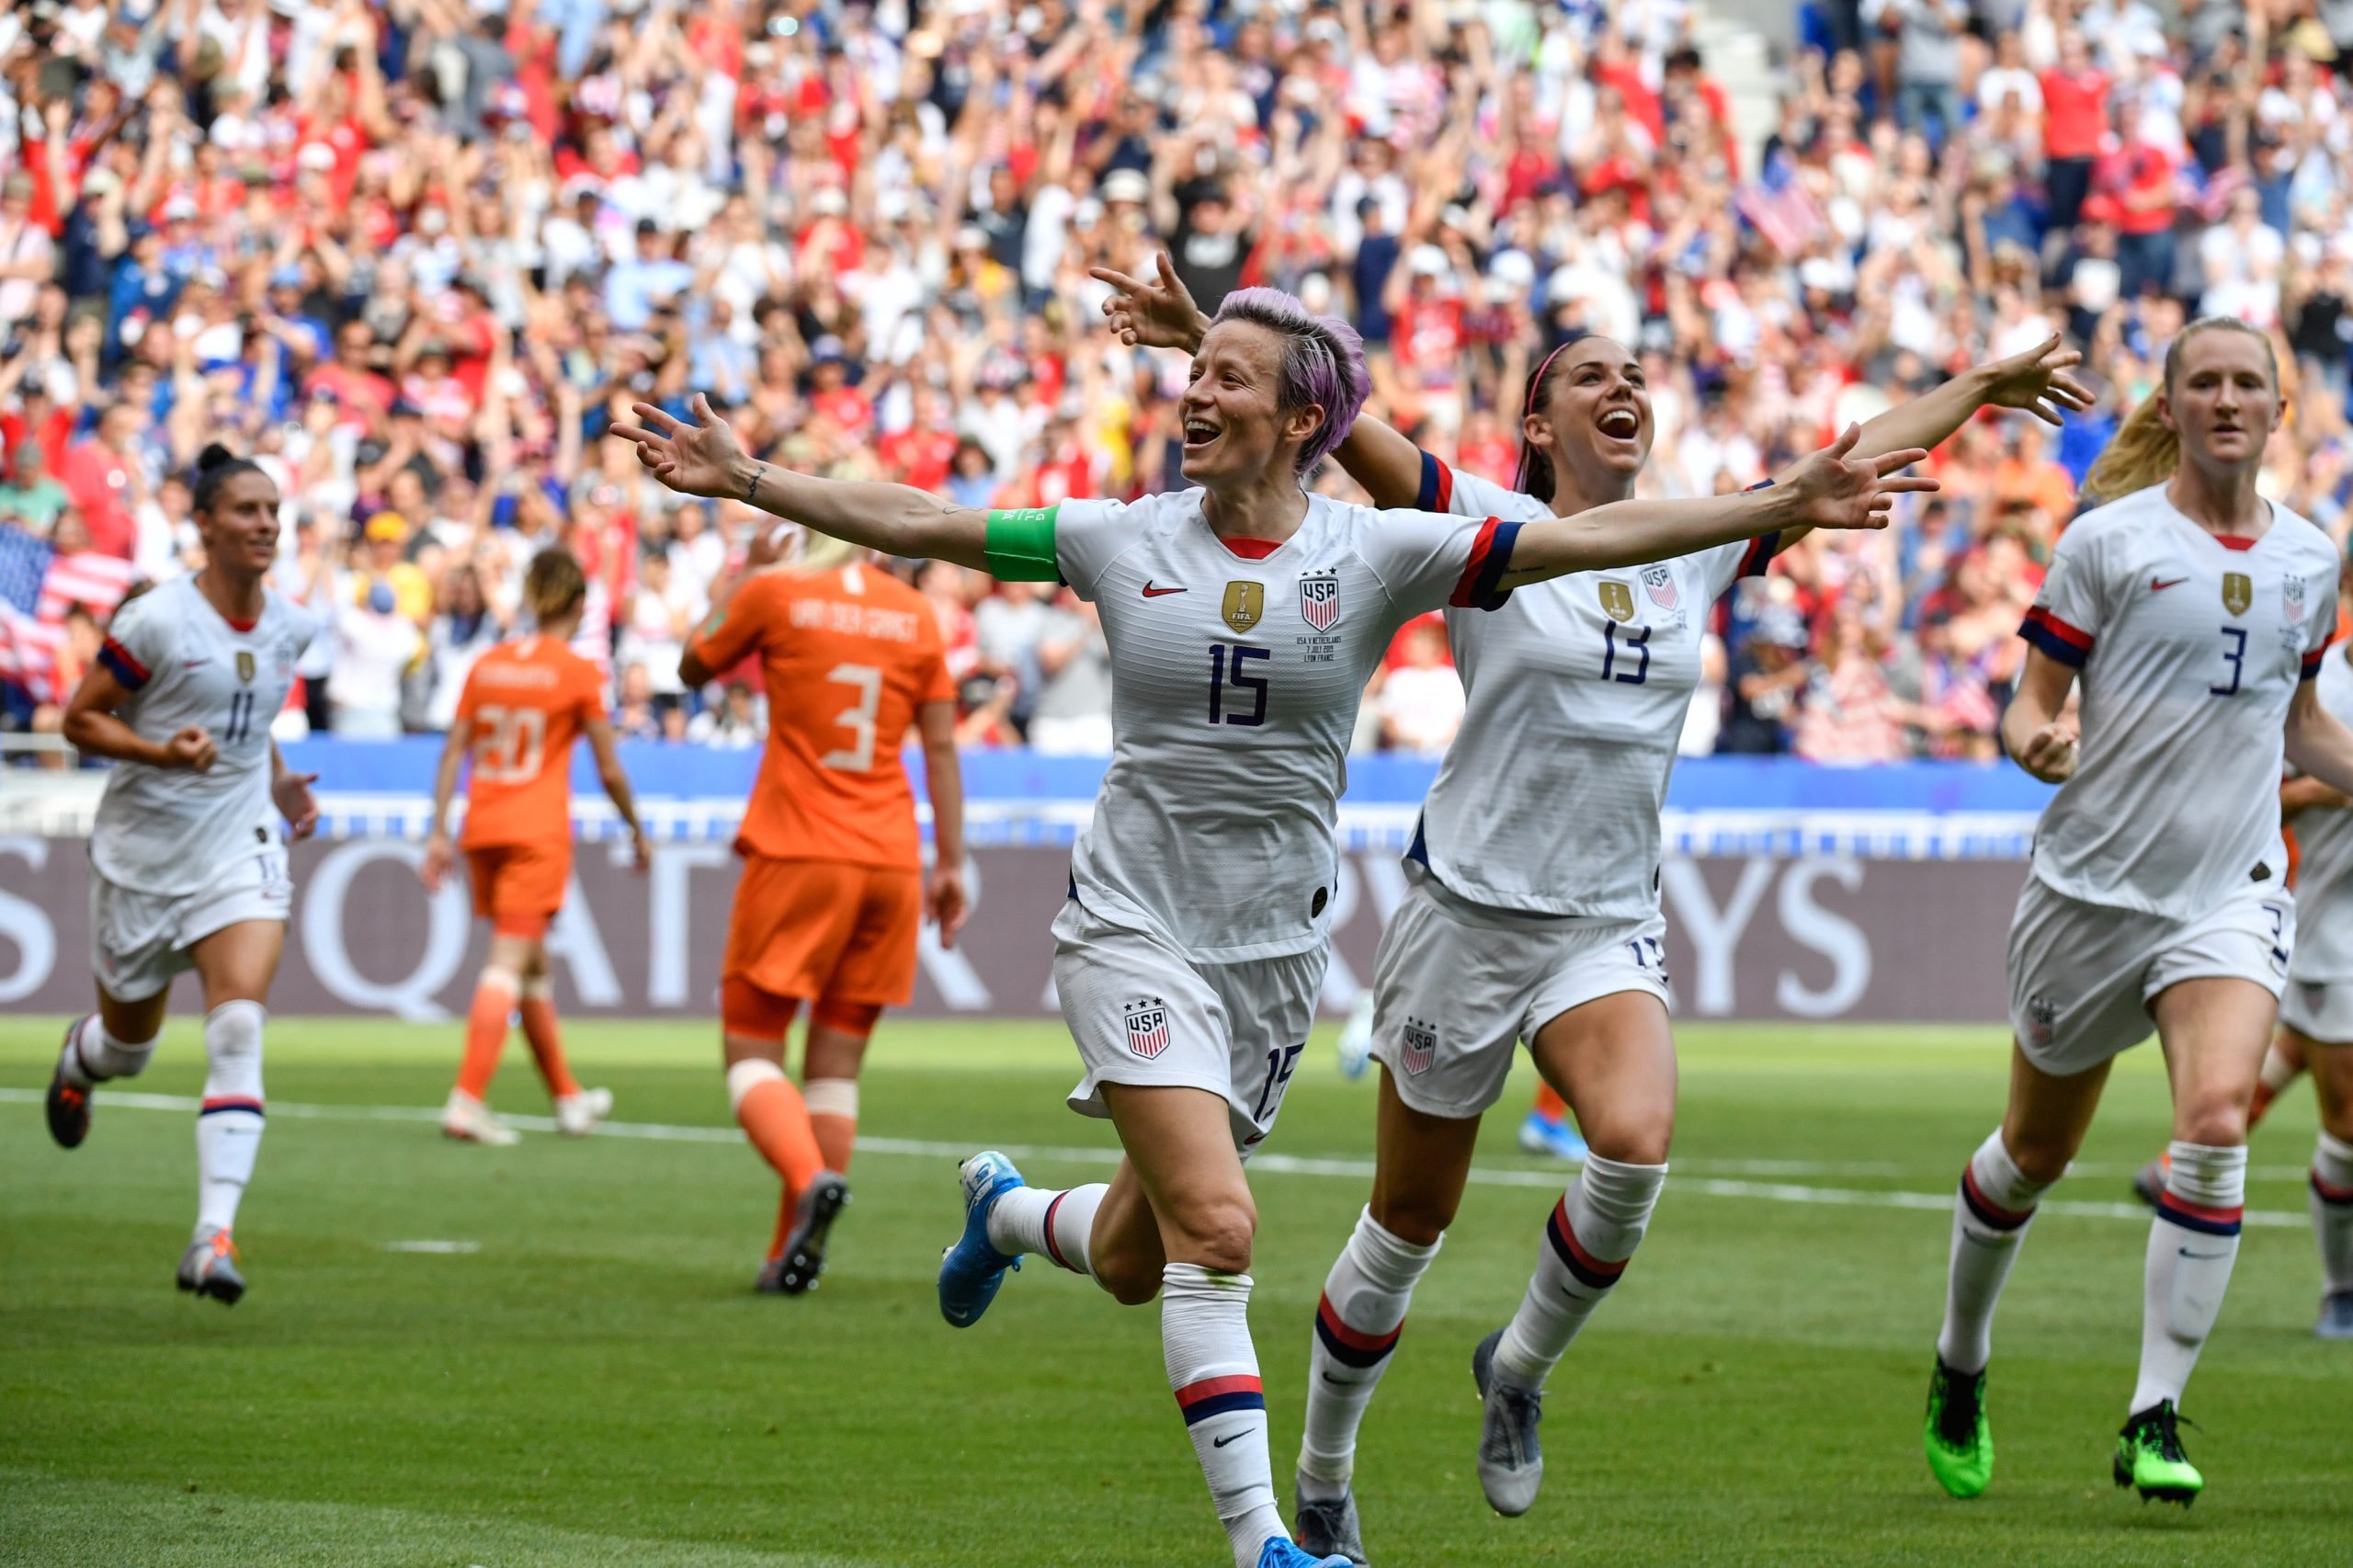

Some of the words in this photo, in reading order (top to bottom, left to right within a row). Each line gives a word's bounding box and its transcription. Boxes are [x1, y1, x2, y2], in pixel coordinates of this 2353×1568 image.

[1303, 583, 1336, 602] USA
[1644, 568, 1668, 587] USA
[1232, 612, 1251, 620] FIFA
[1296, 636, 1306, 644] USA
[1600, 619, 1652, 685] 13
[2210, 627, 2247, 696] 3
[1209, 644, 1270, 727] 15
[224, 690, 254, 745] 11
[819, 662, 882, 773] 3
[473, 703, 548, 786] 20
[1129, 1012, 1163, 1032] USA
[1407, 1029, 1433, 1050] USA
